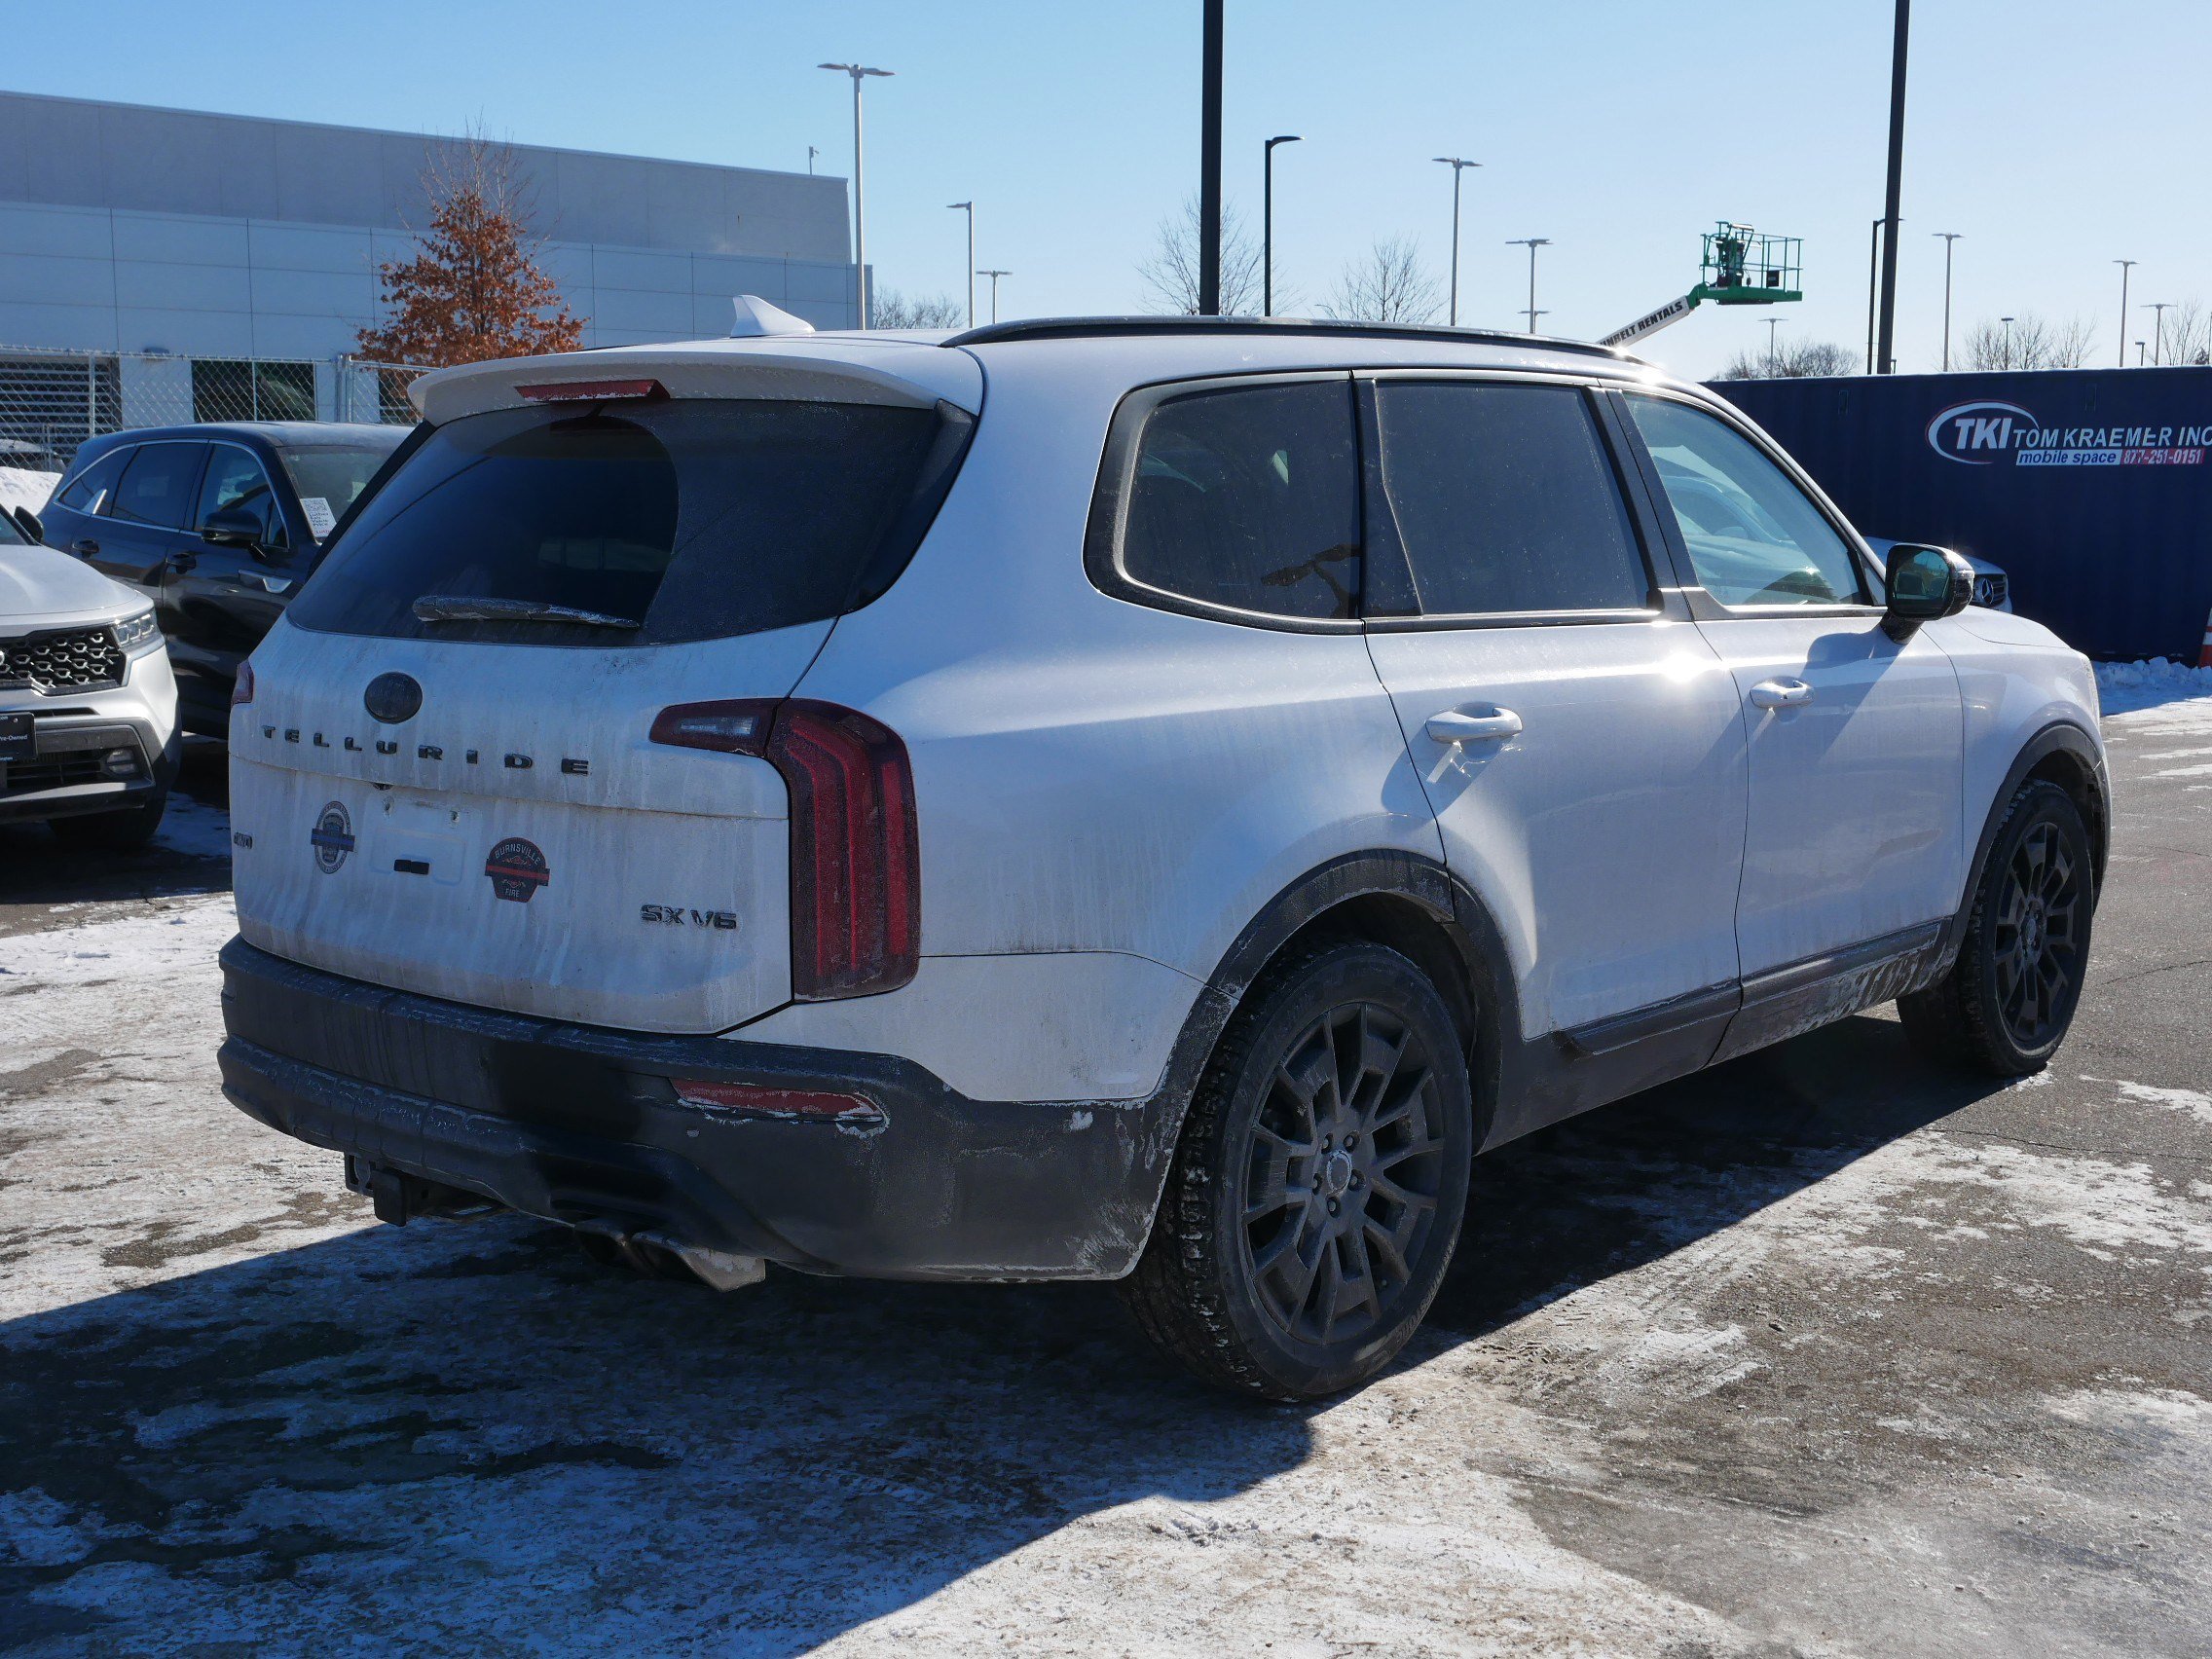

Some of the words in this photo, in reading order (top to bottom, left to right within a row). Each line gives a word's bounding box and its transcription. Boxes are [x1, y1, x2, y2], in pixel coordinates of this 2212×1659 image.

[1600, 324, 1636, 348] NBELT
[1638, 301, 1683, 331] RENTALS
[1954, 417, 2012, 450] TKI
[2012, 428, 2059, 448] TOM
[2062, 426, 2173, 448] KRAEMER
[2018, 450, 2069, 464] mobile
[2072, 452, 2117, 465] space
[2123, 449, 2202, 464] 877-251-0151
[262, 724, 589, 776] TELLURIDE
[495, 843, 541, 866] BURNSVILLE
[504, 888, 521, 898] FIRE
[641, 904, 684, 926] SX
[689, 909, 737, 930] V6
